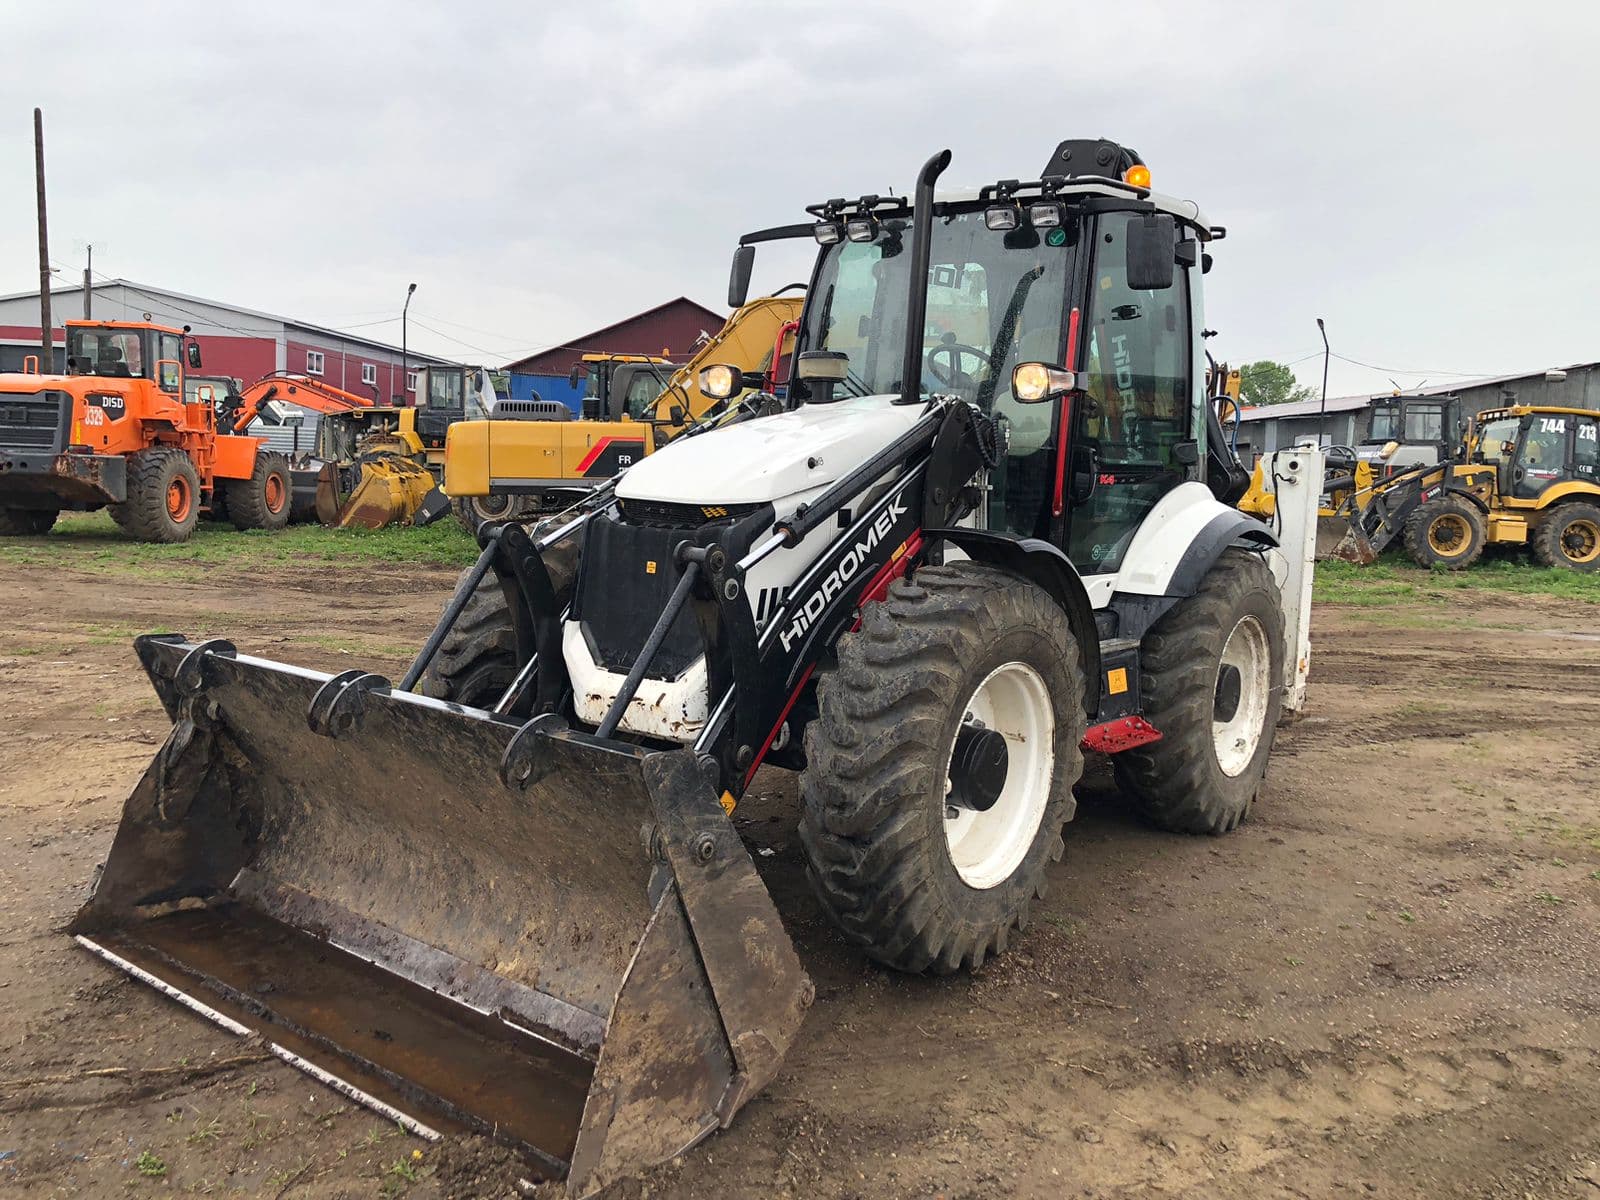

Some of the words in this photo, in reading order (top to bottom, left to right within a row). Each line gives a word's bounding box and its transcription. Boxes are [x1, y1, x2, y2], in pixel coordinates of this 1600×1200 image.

[1540, 418, 1565, 433] 744
[1579, 424, 1596, 442] 213
[618, 455, 631, 464] FR
